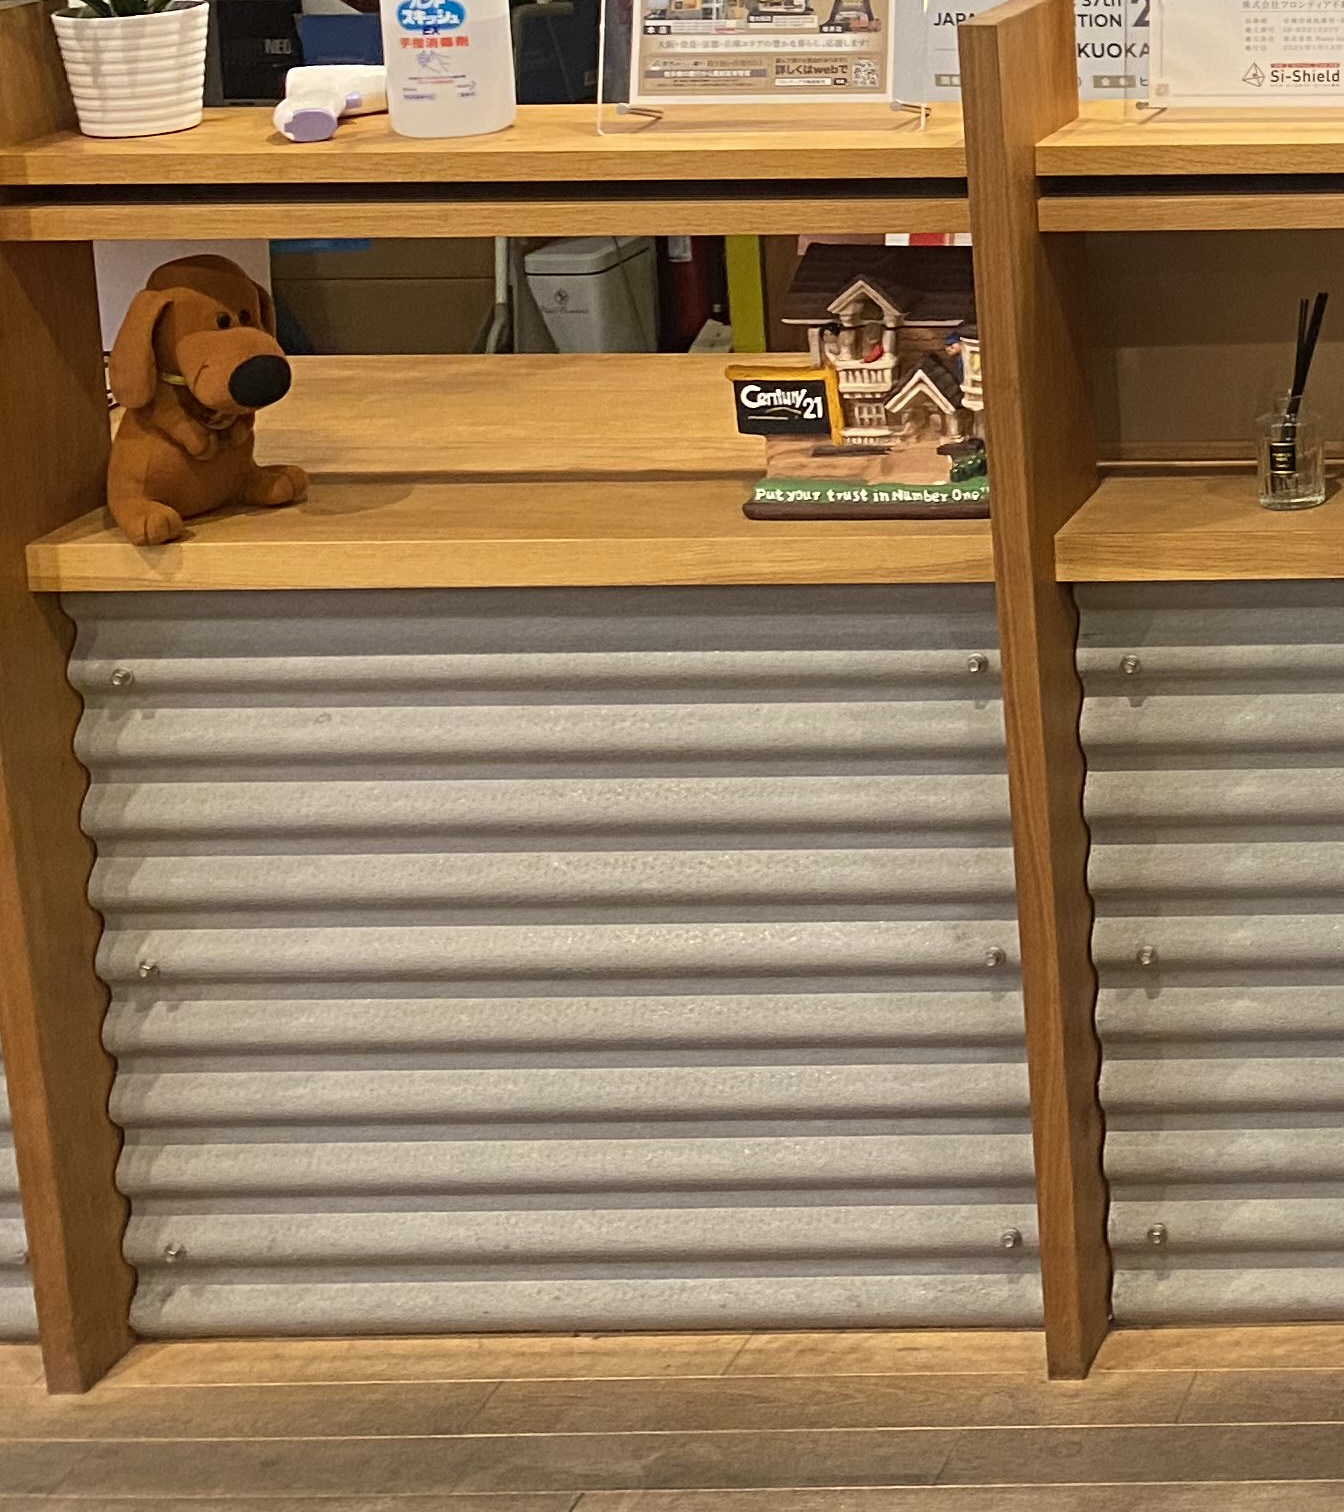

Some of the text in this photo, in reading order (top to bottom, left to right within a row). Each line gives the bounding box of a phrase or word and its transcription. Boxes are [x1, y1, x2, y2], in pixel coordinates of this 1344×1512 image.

[1270, 69, 1341, 83] Si-Shield
[740, 384, 823, 420] Century 21
[755, 487, 784, 502] Put
[784, 489, 821, 502] your
[826, 487, 868, 502] trust
[873, 488, 890, 502] in
[891, 488, 948, 503] Number
